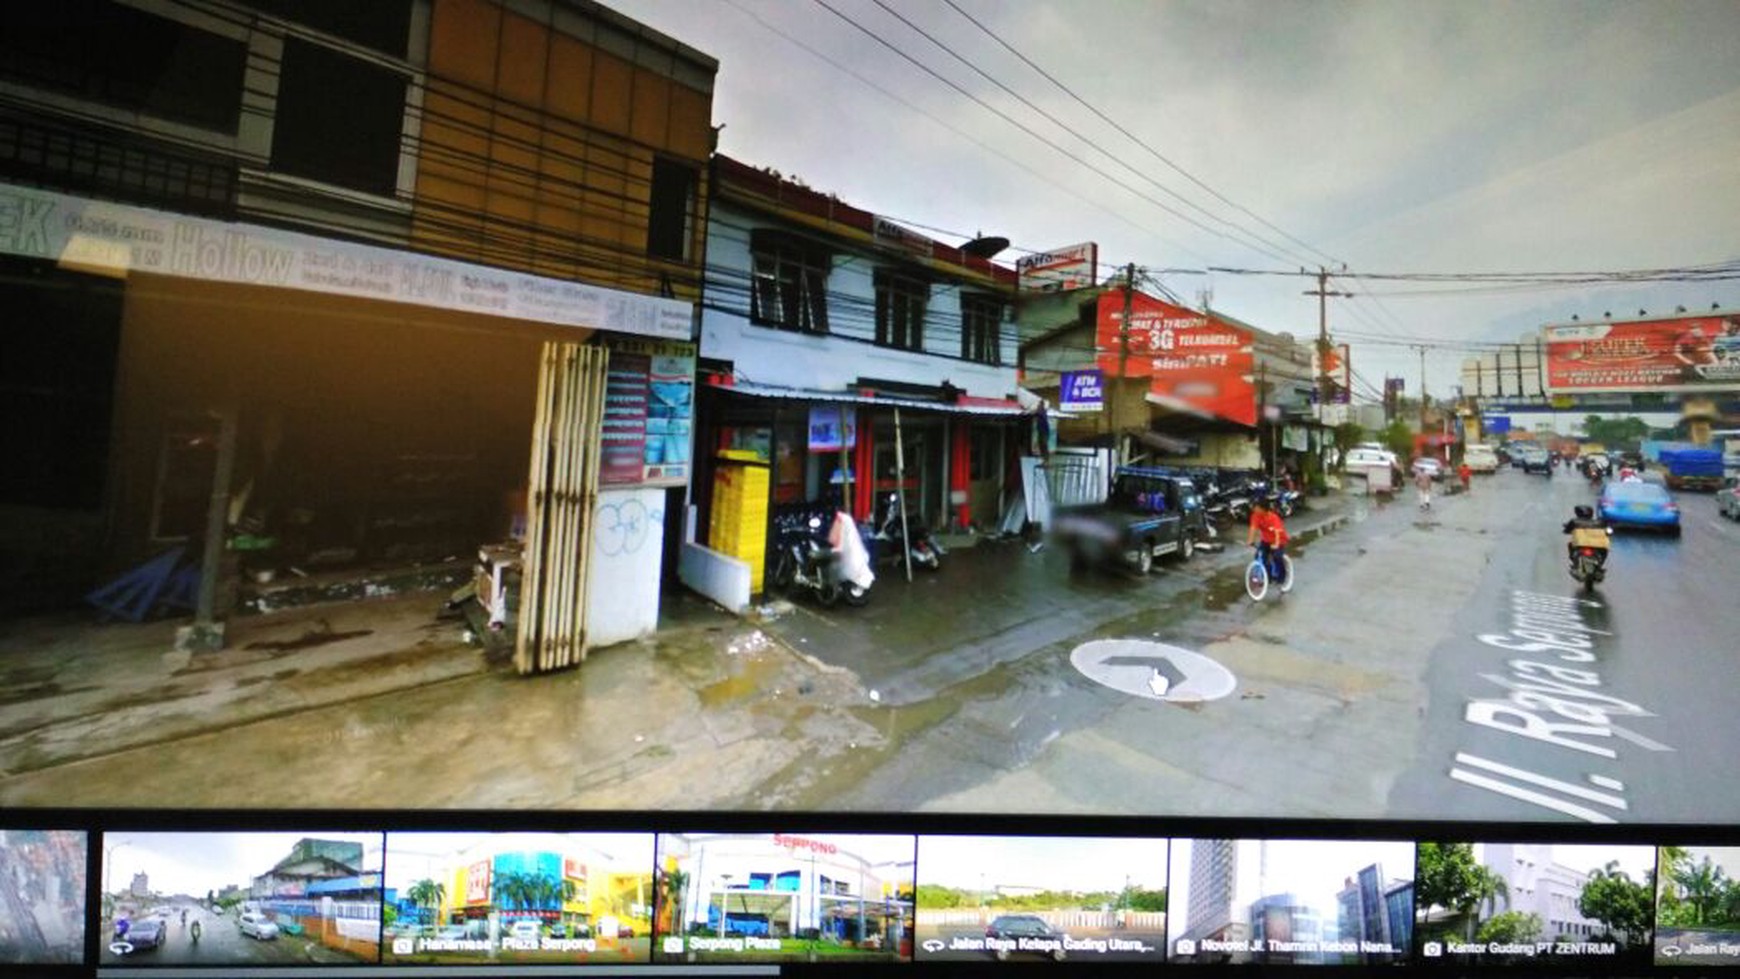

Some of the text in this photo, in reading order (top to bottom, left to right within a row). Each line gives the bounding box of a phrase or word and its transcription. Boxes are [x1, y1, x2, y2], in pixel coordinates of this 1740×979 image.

[173, 224, 294, 283] Hollow
[1149, 329, 1174, 350] 3G
[1074, 375, 1098, 386] ATM
[1465, 659, 1645, 759] Raya
[421, 938, 492, 951] Hanamasa
[502, 937, 540, 951] Plaza
[541, 938, 596, 953] Serpong
[689, 937, 781, 952] Serpong Plaza
[949, 937, 983, 950] Jalan
[985, 937, 1016, 952] Raya
[1018, 937, 1062, 952] Kelapa
[1064, 936, 1108, 953] Gading
[1202, 939, 1248, 951] Novotel
[1267, 940, 1318, 952] Thamrin
[1320, 940, 1358, 952] Kebon
[1447, 941, 1616, 956] Kantor Gudang PT ZENTRUM
[1686, 943, 1717, 955] Jalan
